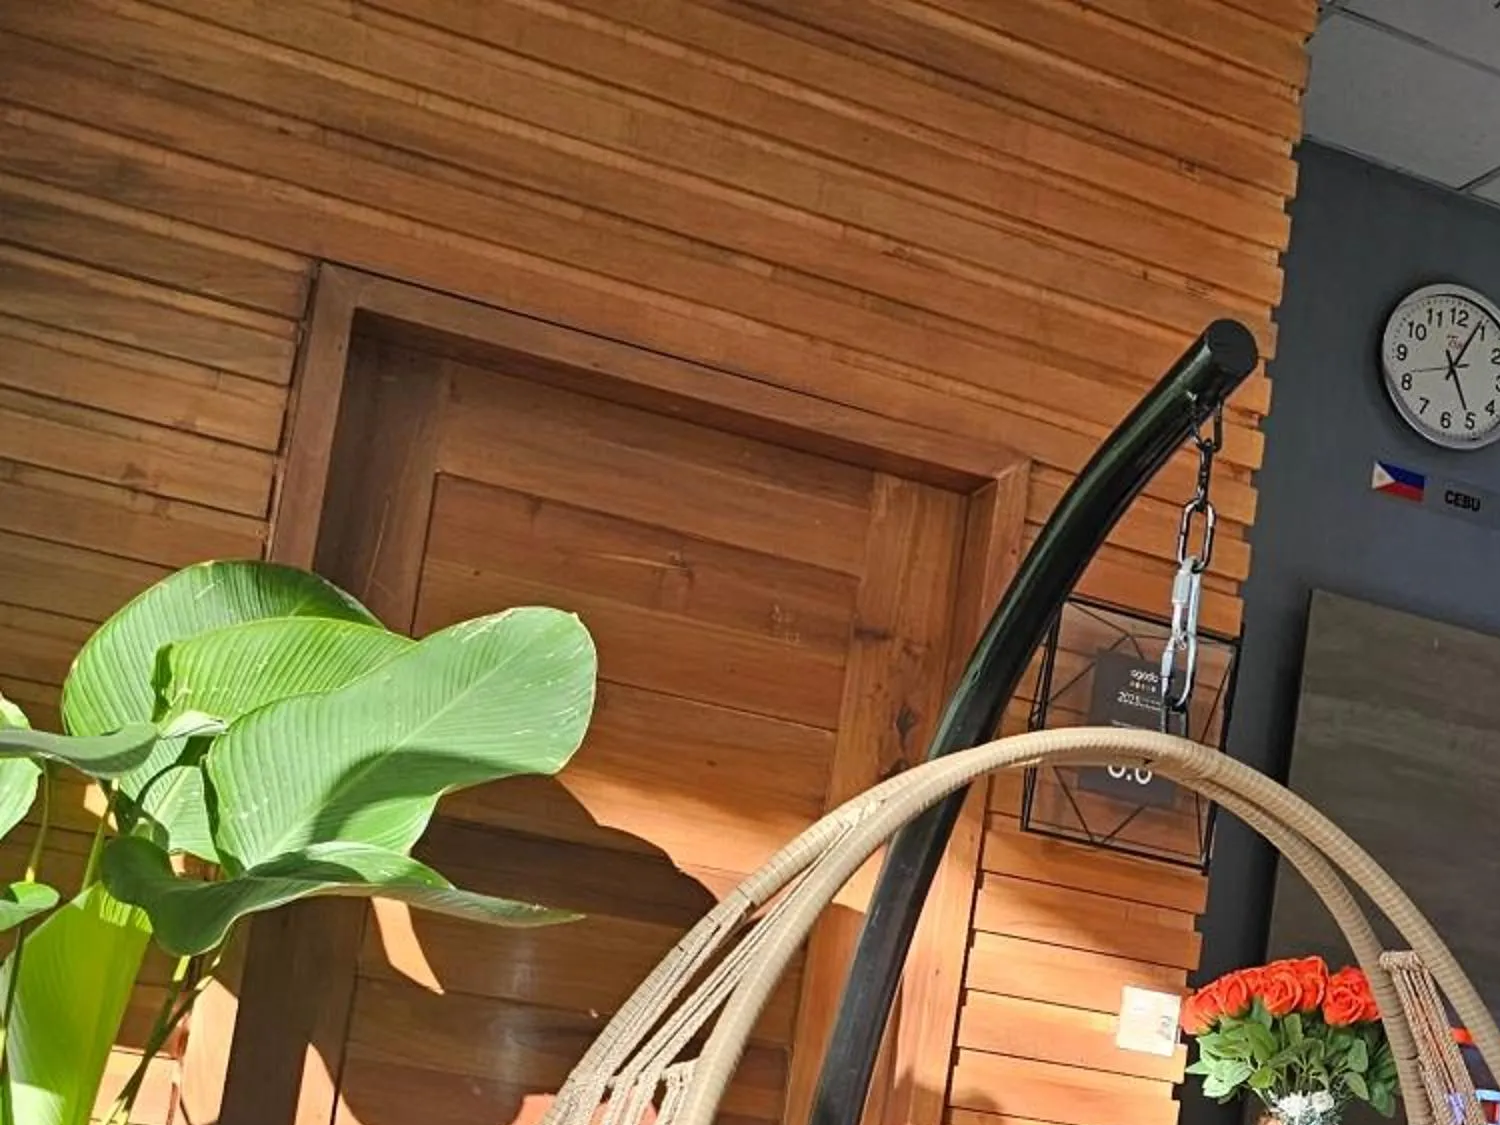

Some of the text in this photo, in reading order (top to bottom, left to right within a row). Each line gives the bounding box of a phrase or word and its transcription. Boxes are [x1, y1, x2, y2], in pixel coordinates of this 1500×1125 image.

[1427, 308, 1443, 328] 11
[1450, 307, 1469, 327] 12
[1408, 321, 1427, 341] 10
[1479, 325, 1485, 342] 1
[1396, 344, 1408, 361] 9
[1401, 373, 1413, 391] 8
[1419, 397, 1430, 414] 7
[1485, 399, 1495, 417] 4
[1440, 411, 1452, 429] 6
[1464, 412, 1477, 430] 5
[1444, 490, 1481, 512] CEBU
